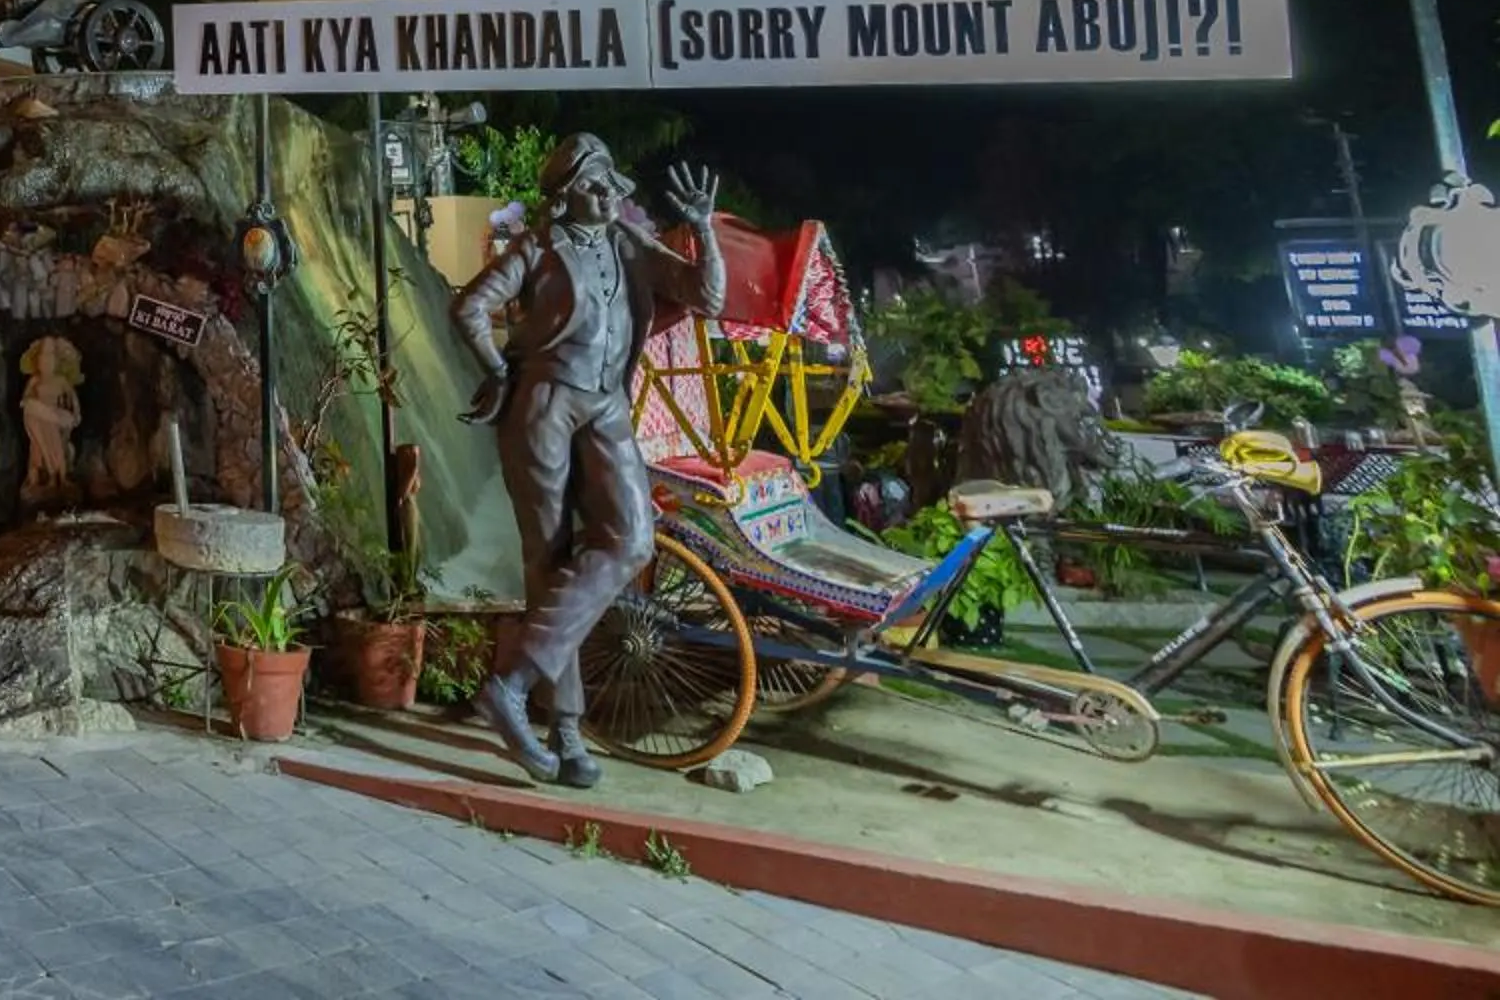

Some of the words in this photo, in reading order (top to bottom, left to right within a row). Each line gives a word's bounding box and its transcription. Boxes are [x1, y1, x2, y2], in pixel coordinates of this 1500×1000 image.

[200, 18, 287, 75] AATI
[303, 16, 381, 73] KYA
[395, 8, 628, 72] KHANDALA
